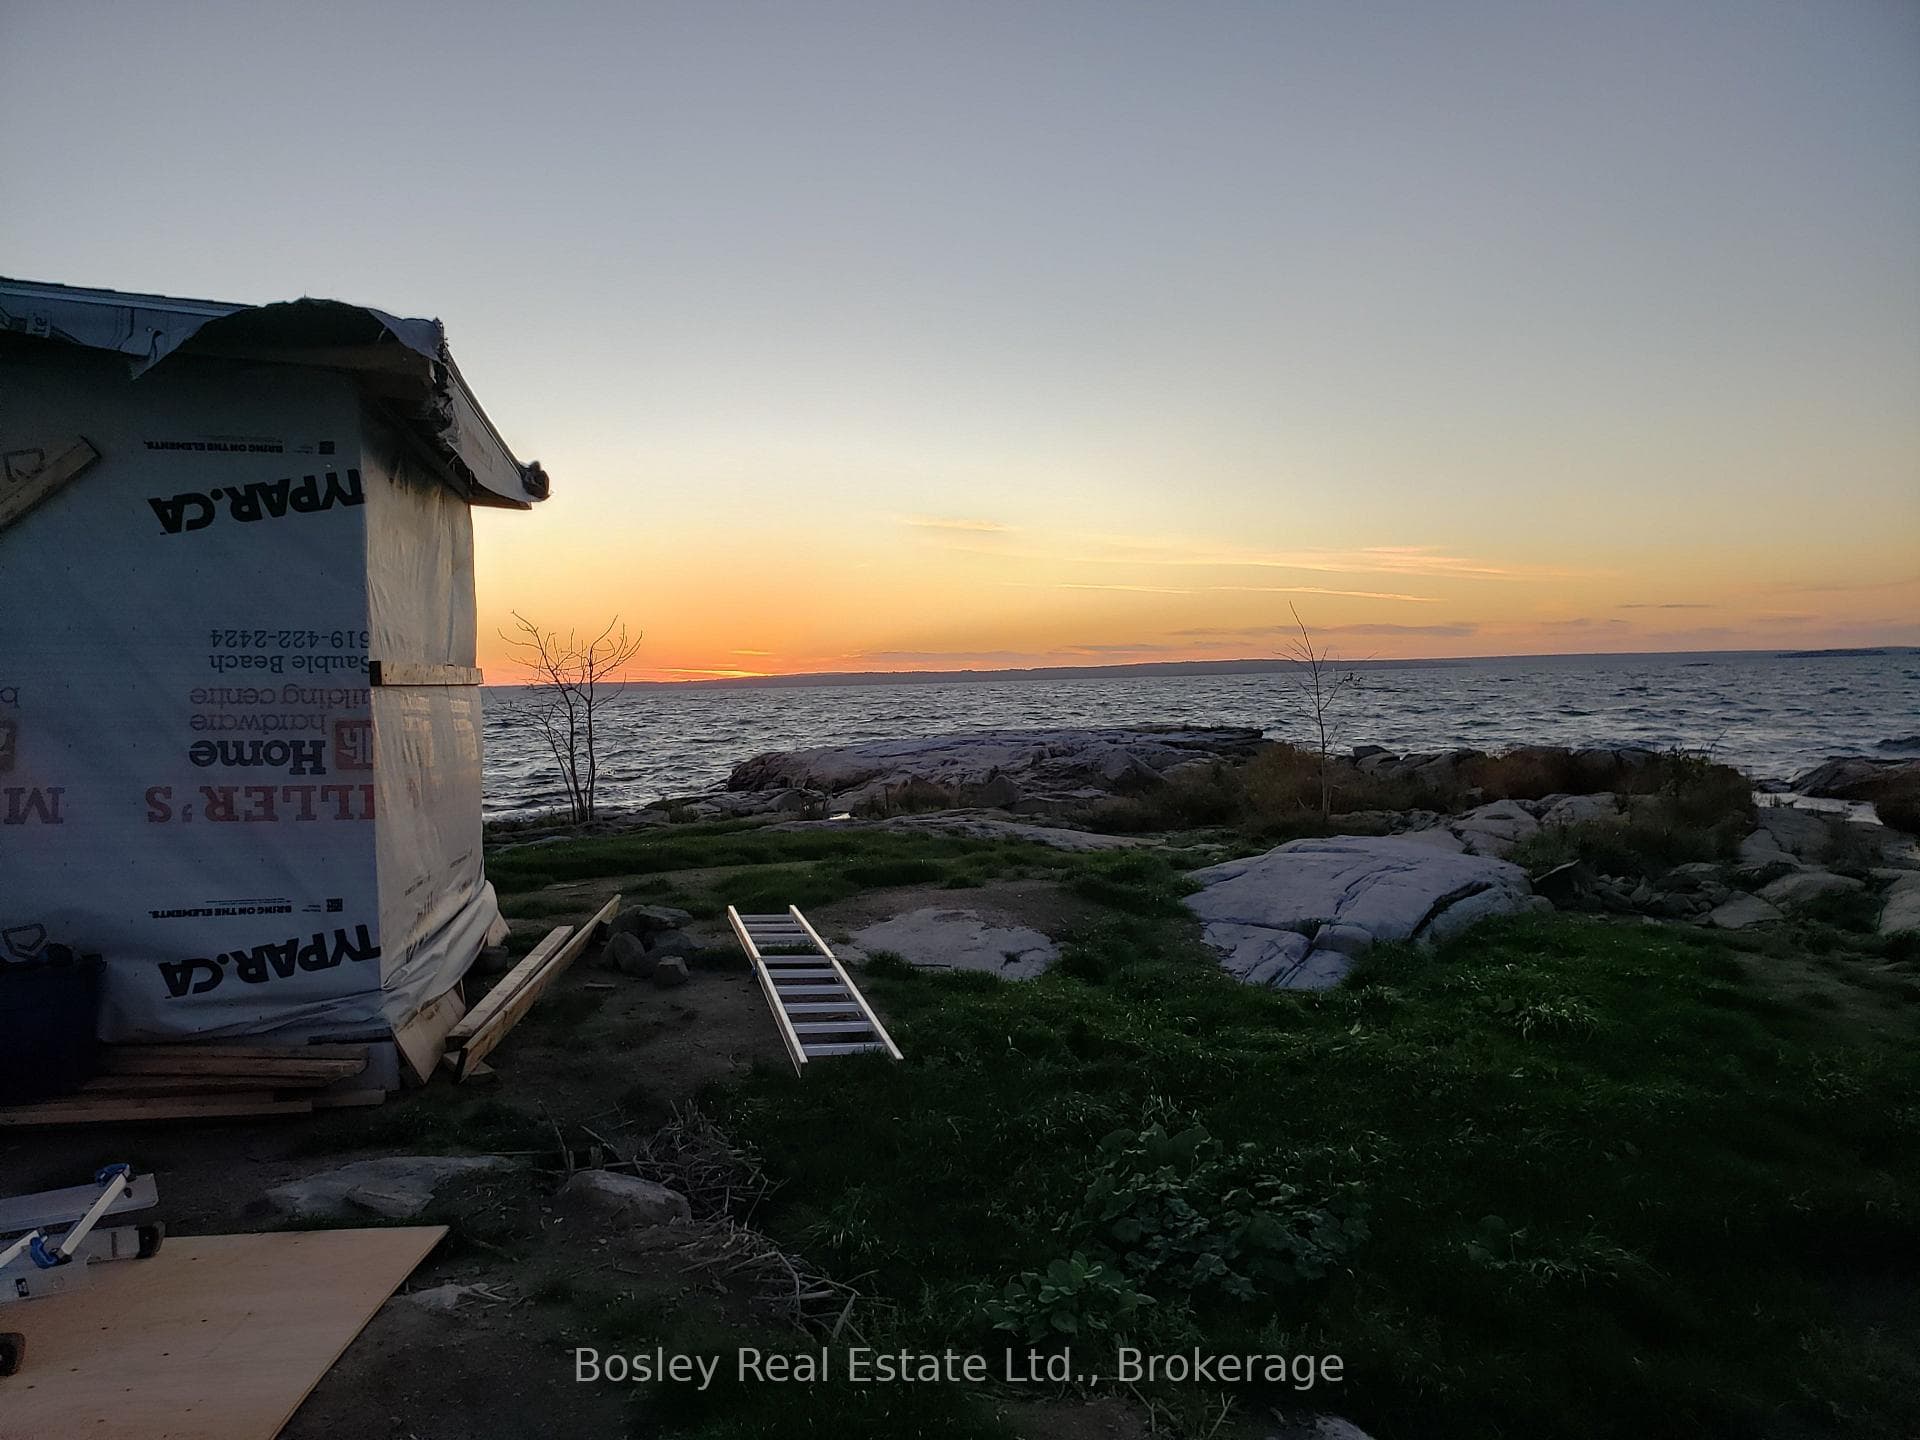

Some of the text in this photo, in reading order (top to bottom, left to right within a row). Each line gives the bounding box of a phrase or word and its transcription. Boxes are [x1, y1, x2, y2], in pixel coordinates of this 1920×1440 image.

[148, 468, 365, 534] TYPAR.CA
[209, 654, 370, 674] Sauble Beach
[190, 687, 275, 705] centre
[190, 713, 327, 733] hardware
[189, 739, 327, 776] Home
[148, 908, 213, 919] ELEMENTS.
[214, 907, 237, 916] THE
[239, 906, 256, 915] ON
[257, 904, 292, 914] BRING
[158, 923, 382, 999] TYPAR.CA
